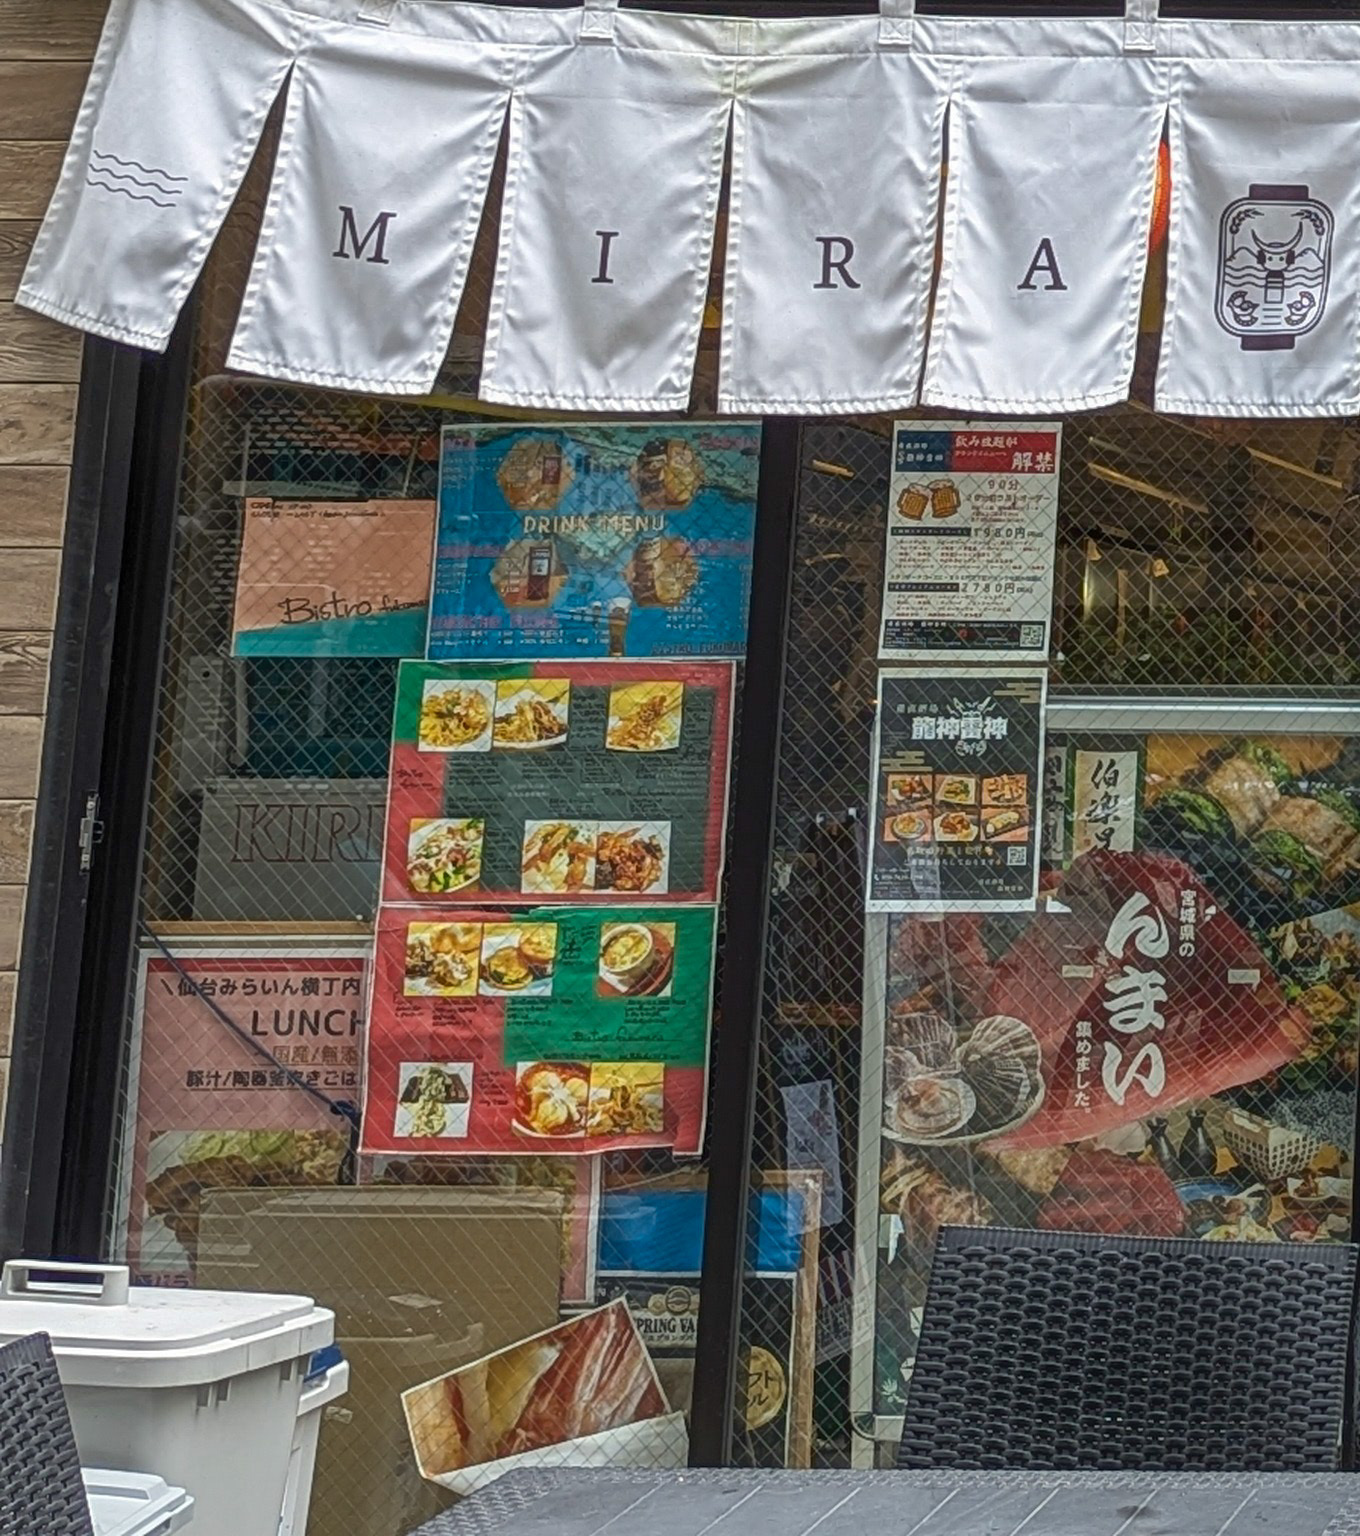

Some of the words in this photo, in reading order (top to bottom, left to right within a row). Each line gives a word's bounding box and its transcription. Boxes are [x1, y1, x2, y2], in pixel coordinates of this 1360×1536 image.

[523, 515, 591, 534] DRINK
[602, 514, 667, 533] MENU
[277, 591, 372, 625] Bistro
[1178, 888, 1198, 957] 宮城県の
[1100, 891, 1170, 1106] んまい
[1074, 1020, 1093, 1114] 集めました。
